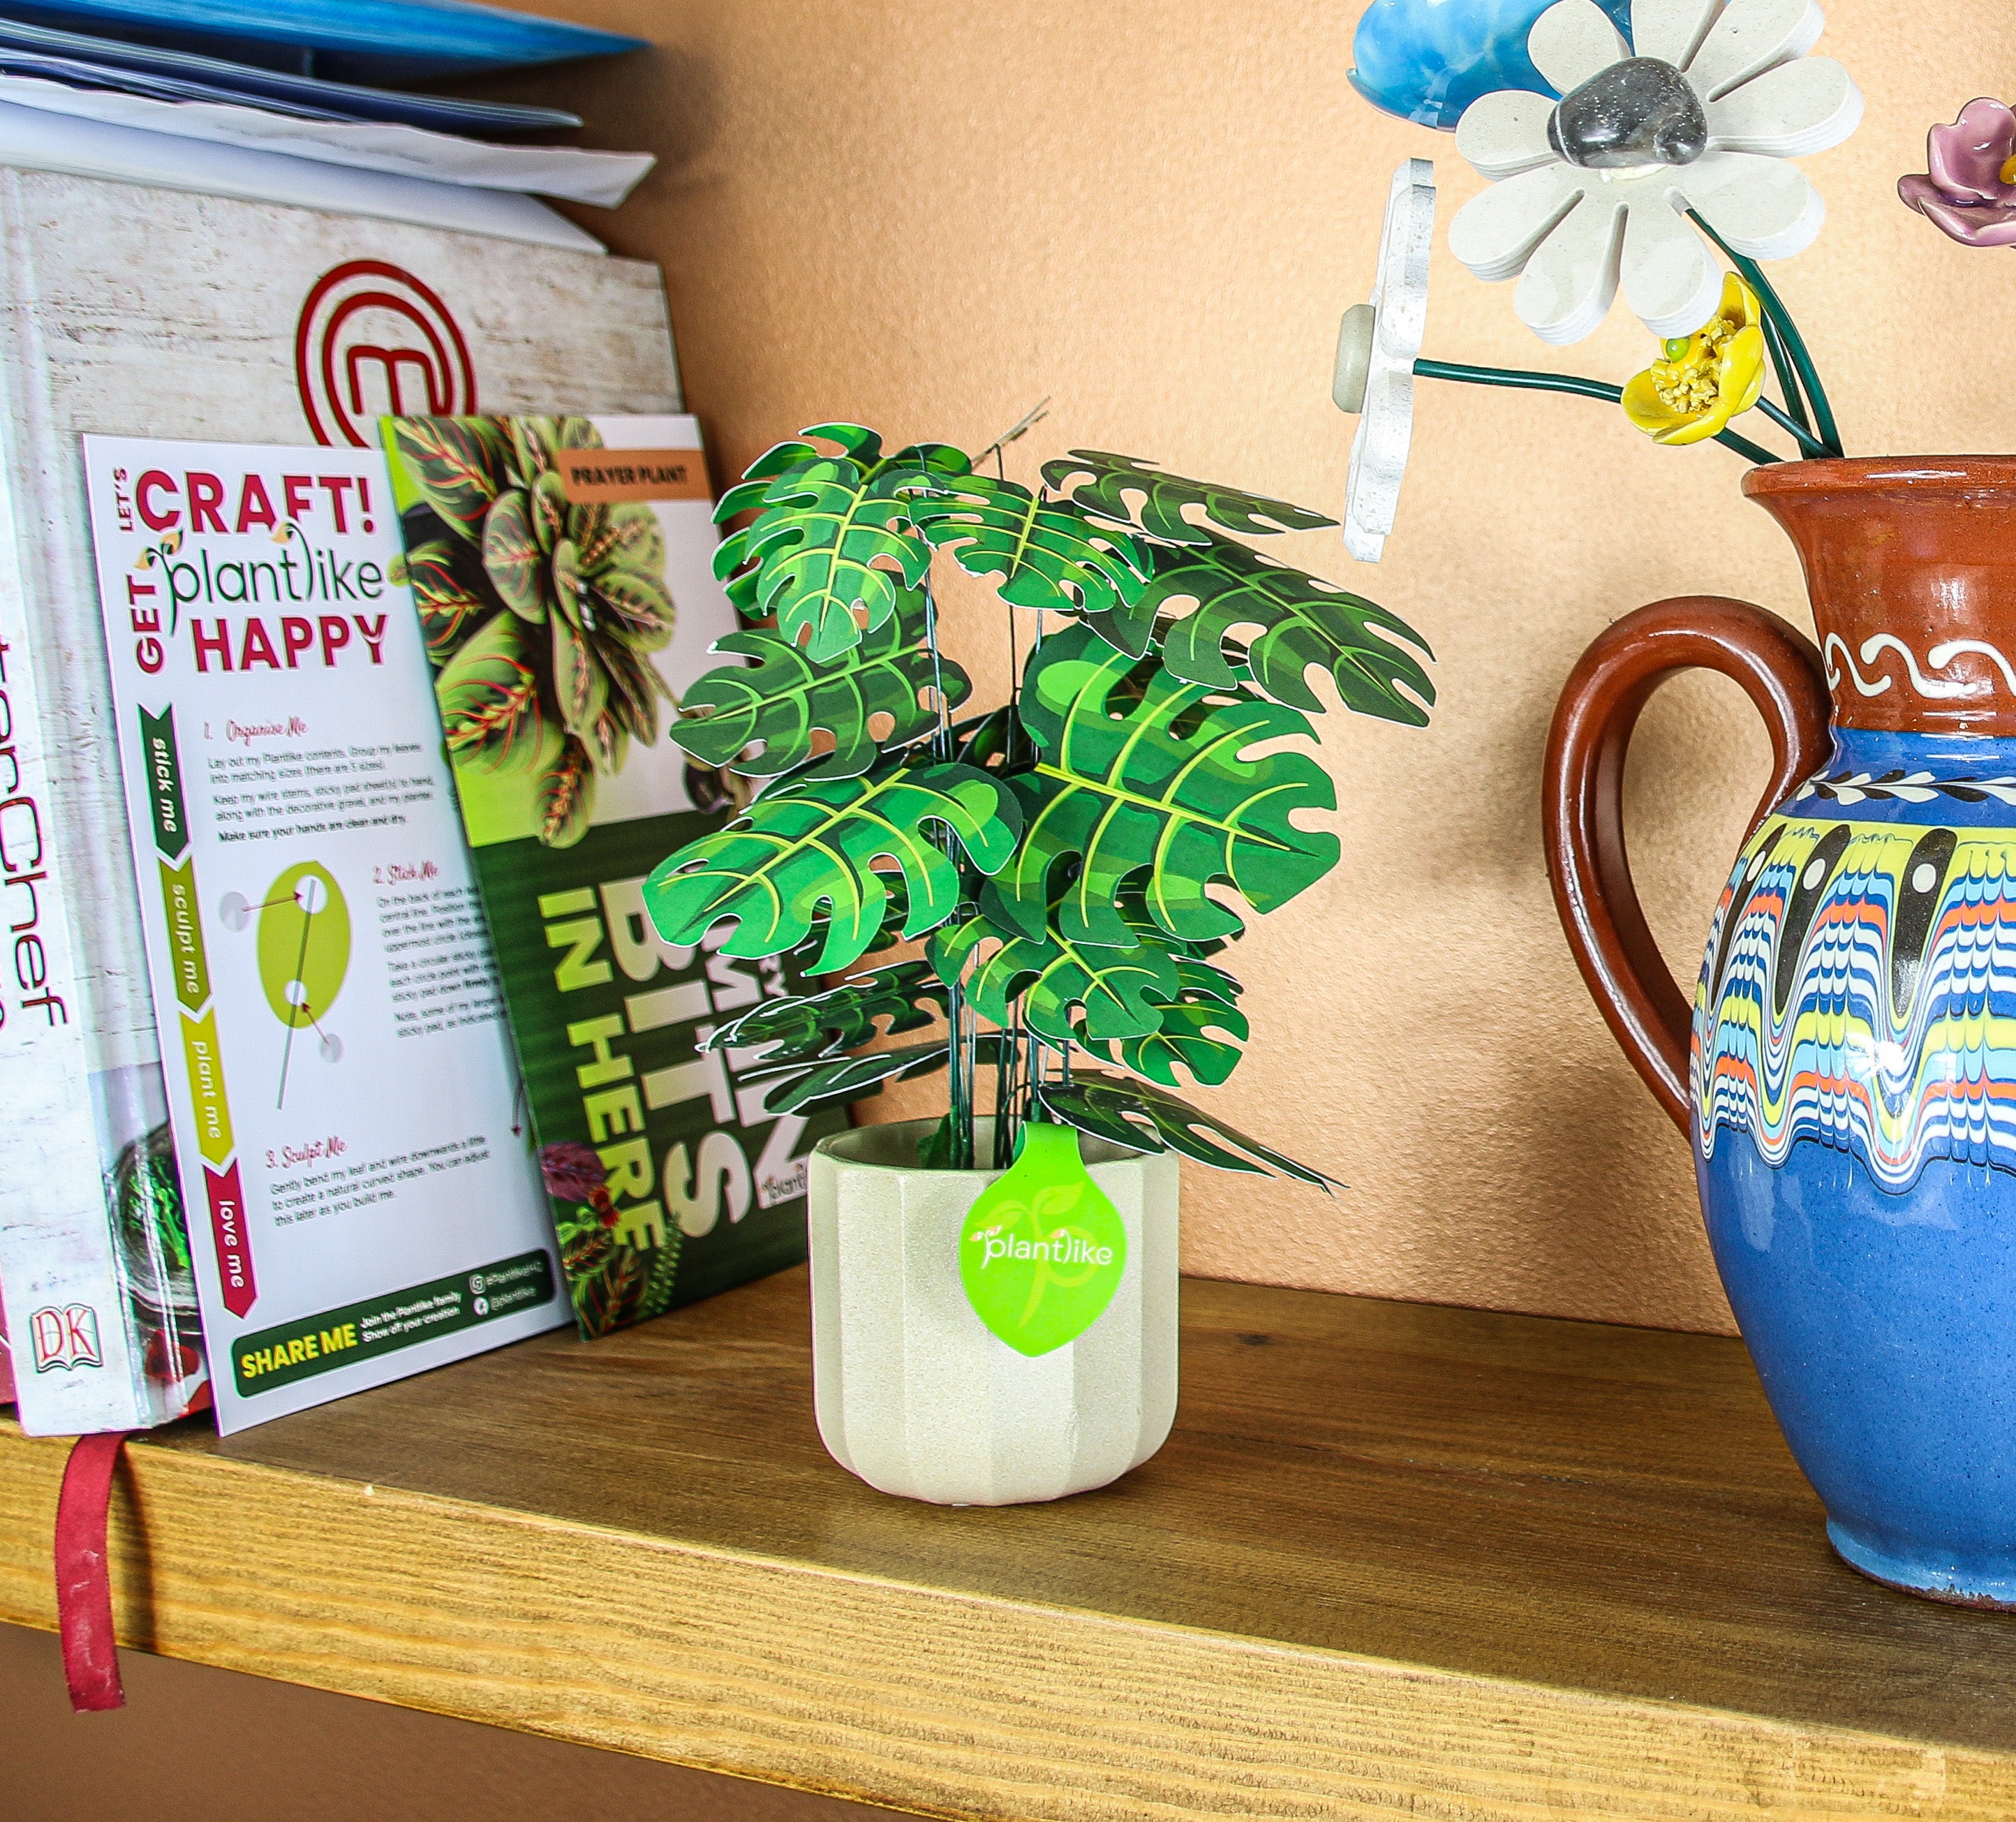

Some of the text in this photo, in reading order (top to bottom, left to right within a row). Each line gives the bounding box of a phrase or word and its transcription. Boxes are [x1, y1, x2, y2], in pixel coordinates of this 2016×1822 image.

[112, 467, 133, 532] LET'S
[136, 468, 376, 534] CRAFT!
[637, 464, 688, 484] PLANT
[128, 575, 165, 674] GET
[155, 522, 385, 636] plantlike
[190, 614, 388, 672] HAPPY
[151, 736, 178, 834] stick me
[172, 882, 200, 995] sculpt me
[538, 885, 614, 992] IN
[191, 1041, 221, 1139] plant me
[600, 876, 752, 1238] BITS
[567, 1012, 669, 1250] HERE
[218, 1199, 244, 1289] love me
[979, 1228, 1113, 1270] plantlike
[34, 1308, 98, 1360] DK
[241, 1323, 359, 1379] SHARE ME
